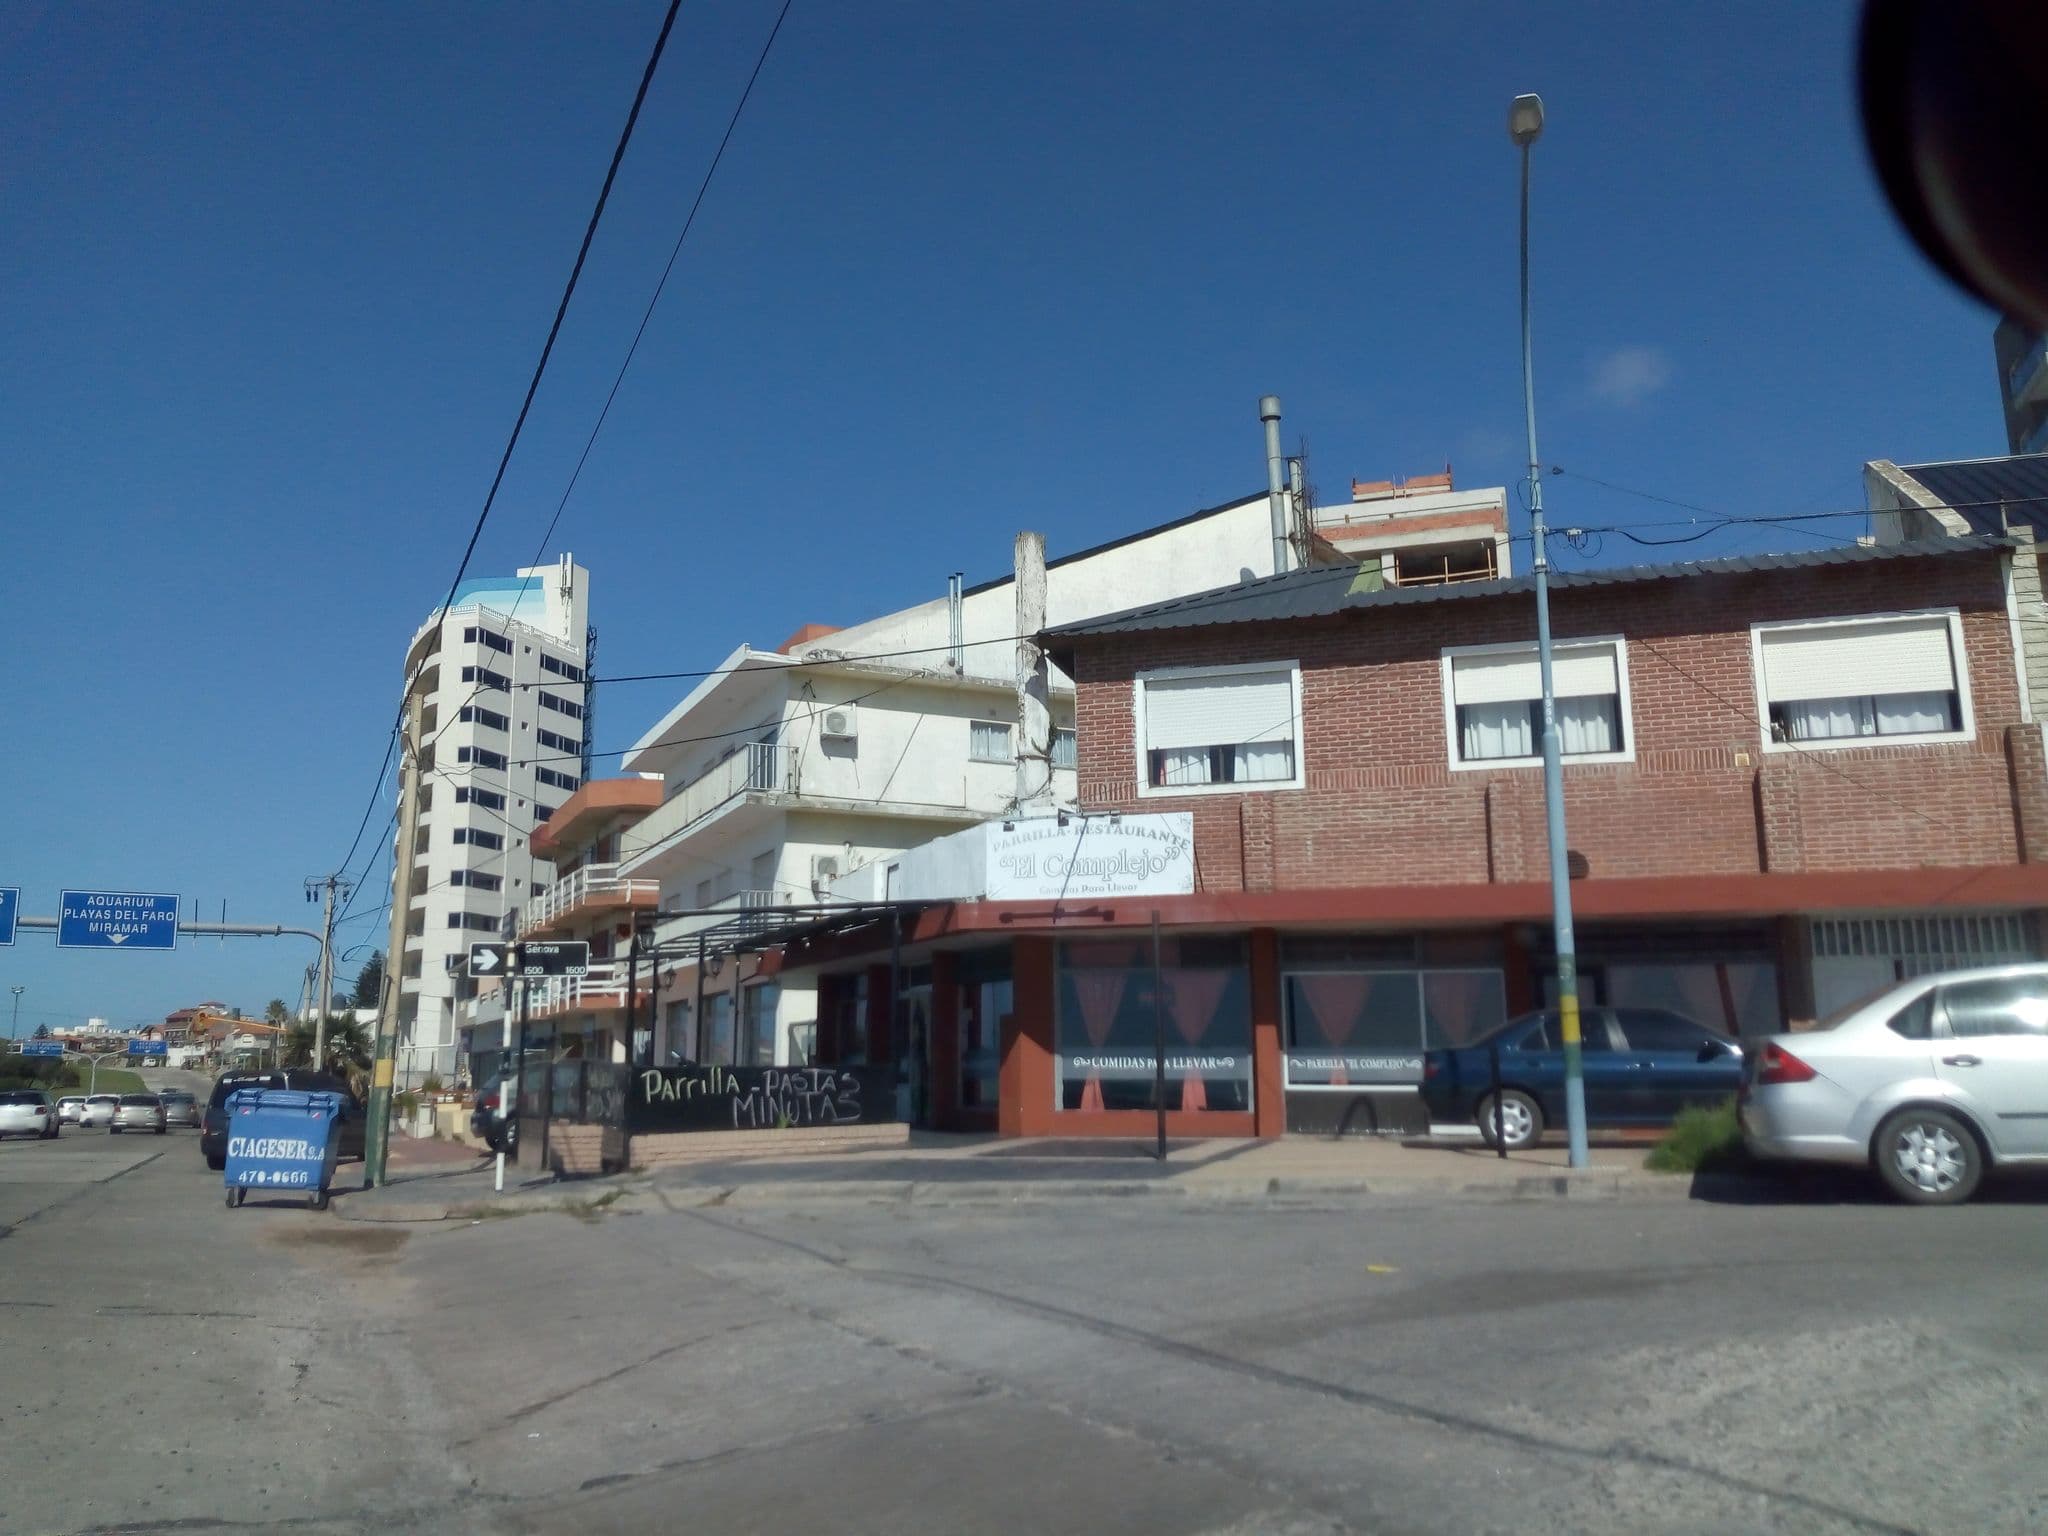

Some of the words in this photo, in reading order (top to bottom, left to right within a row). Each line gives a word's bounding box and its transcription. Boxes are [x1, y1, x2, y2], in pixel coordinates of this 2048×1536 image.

[87, 895, 155, 908] AQUARIUM
[63, 908, 111, 920] PLAYAS
[114, 910, 139, 920] DEL
[141, 911, 175, 922] FARO
[88, 922, 148, 934] MIRAMAR
[524, 966, 544, 975] 1500
[565, 966, 586, 975] 1600
[1092, 1056, 1146, 1069] COMIDAS
[1148, 1058, 1171, 1069] PAA
[228, 1137, 308, 1160] CIAGESER
